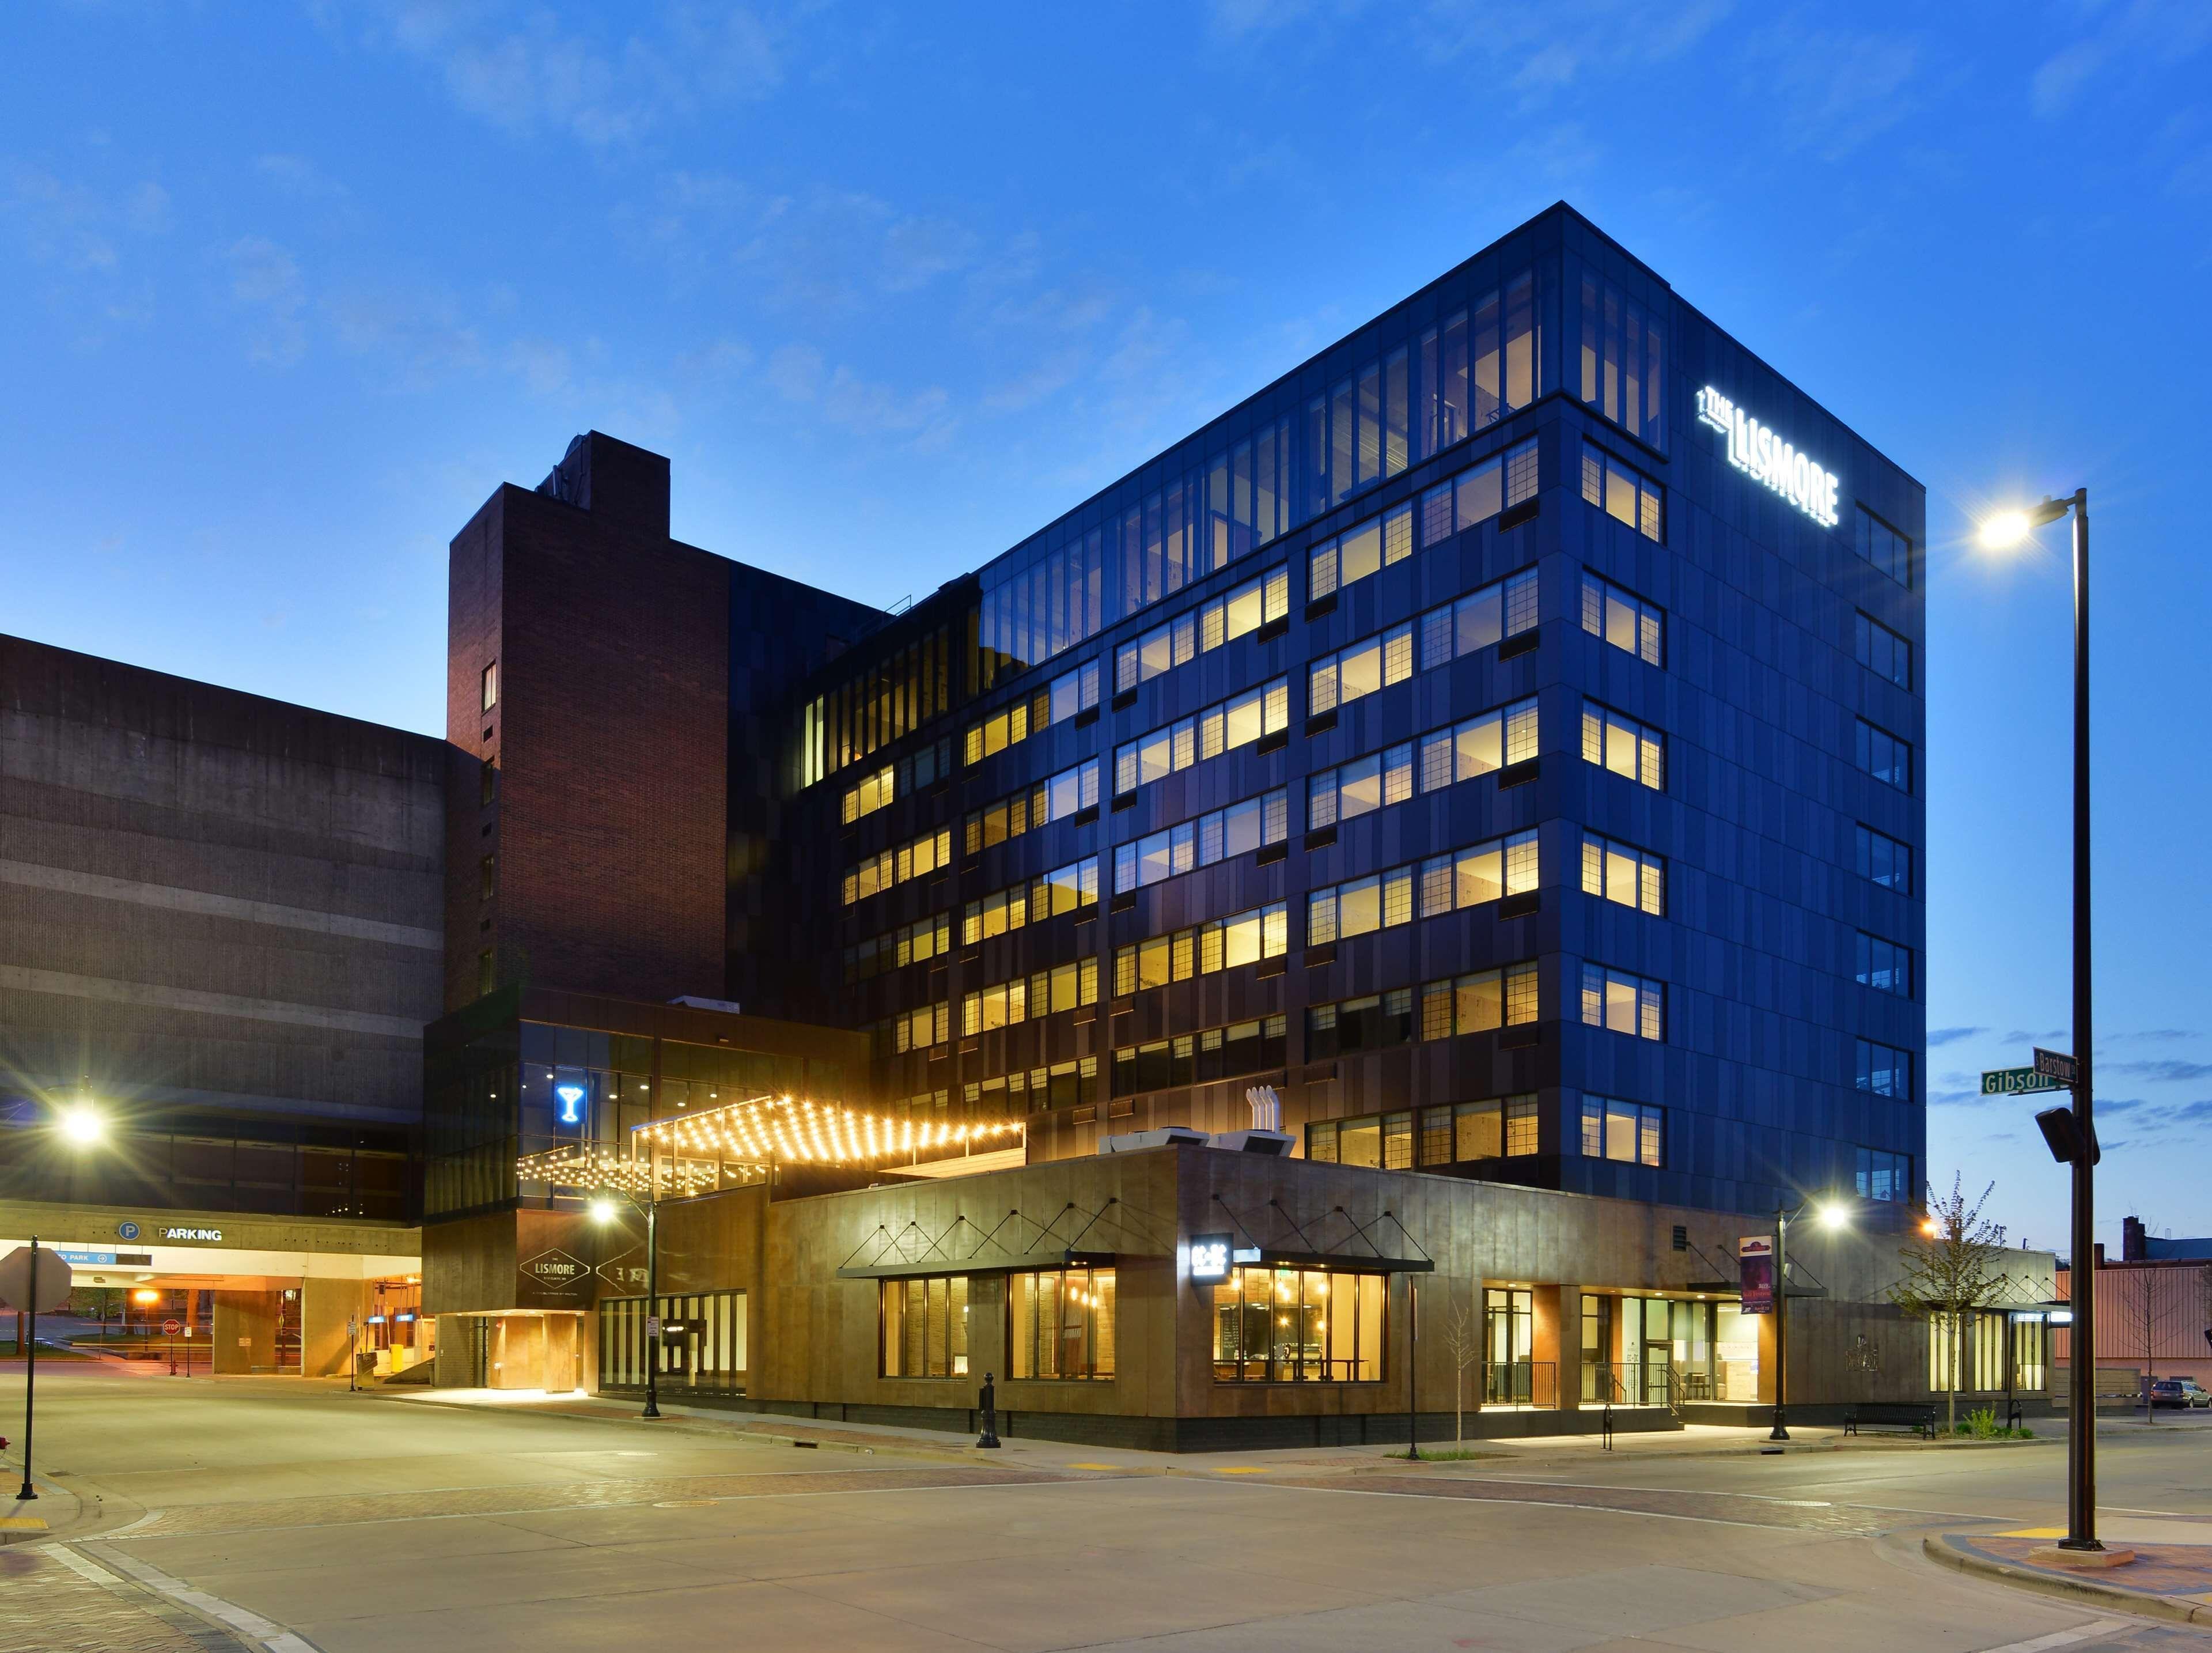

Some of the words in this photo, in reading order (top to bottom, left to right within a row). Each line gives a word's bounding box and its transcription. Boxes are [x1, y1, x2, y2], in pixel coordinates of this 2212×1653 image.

[1705, 385, 1733, 425] THE
[1735, 407, 1839, 525] LISMORE
[2040, 1052, 2070, 1077] Barstow
[1986, 1072, 2048, 1093] Gibson
[126, 1226, 135, 1236] P
[158, 1228, 222, 1241] PARKING
[535, 1263, 575, 1275] LISMORE
